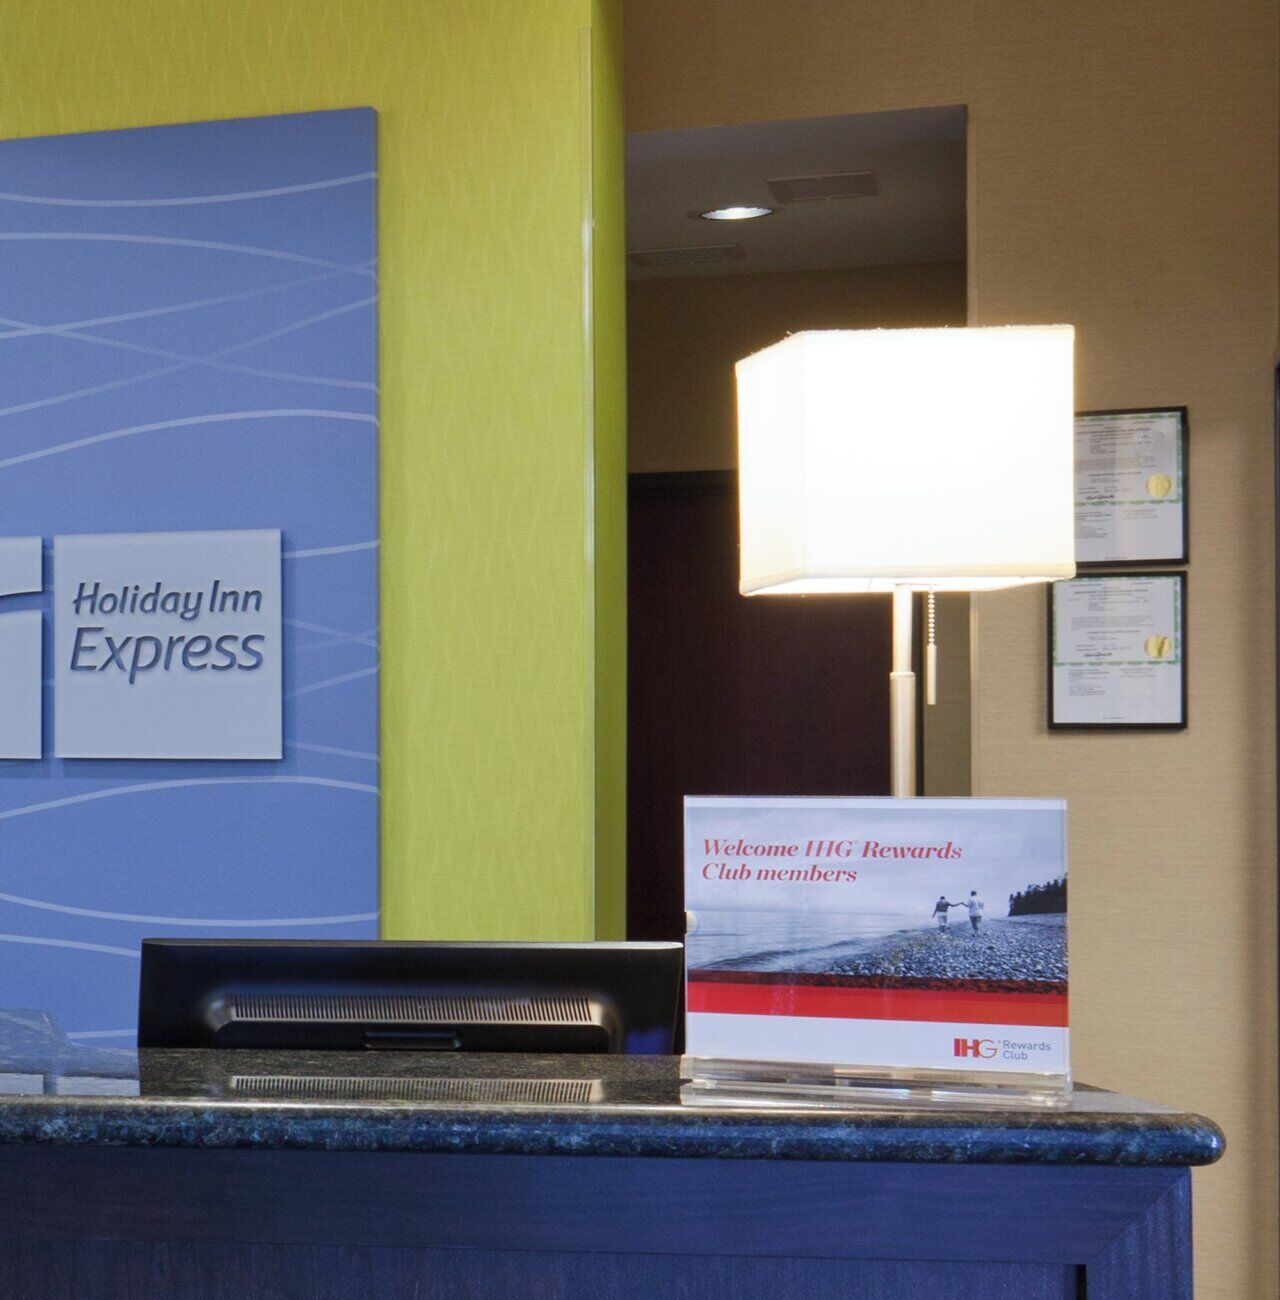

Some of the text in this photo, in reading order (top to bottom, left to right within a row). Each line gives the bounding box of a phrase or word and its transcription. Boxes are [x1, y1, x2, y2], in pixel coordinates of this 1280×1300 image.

[73, 579, 263, 621] Holiday Inn
[69, 626, 265, 685] Express
[703, 838, 799, 858] Welcome
[861, 840, 963, 860] Rewards
[701, 862, 858, 883] Club members
[953, 1037, 1052, 1059] IHG Rewards
[1002, 1050, 1029, 1061] Club
